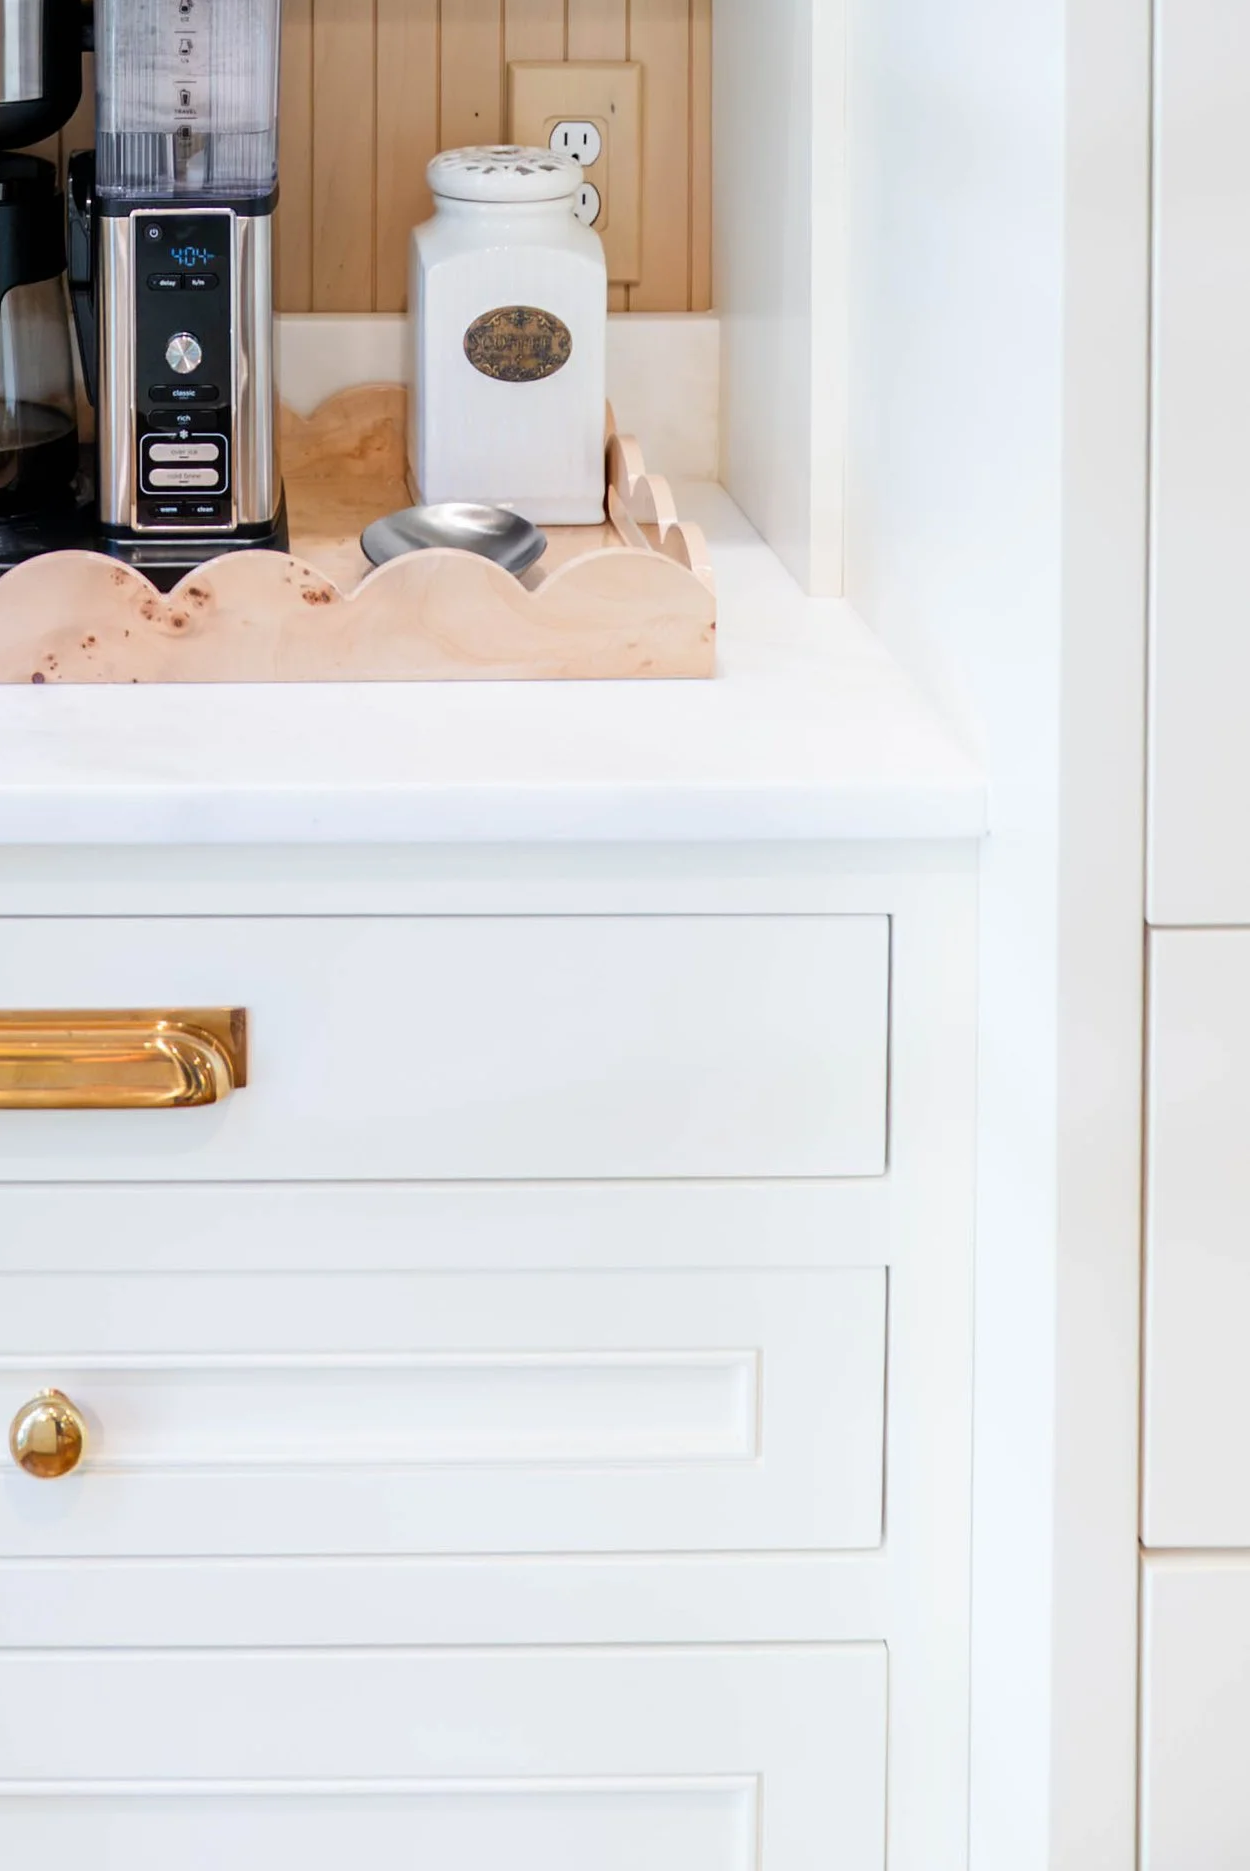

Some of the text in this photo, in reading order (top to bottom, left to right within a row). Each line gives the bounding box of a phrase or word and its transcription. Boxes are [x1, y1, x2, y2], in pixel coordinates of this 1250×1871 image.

[158, 279, 176, 288] delay
[172, 389, 196, 397] classic
[176, 414, 191, 422] rich
[196, 505, 214, 513] clean
